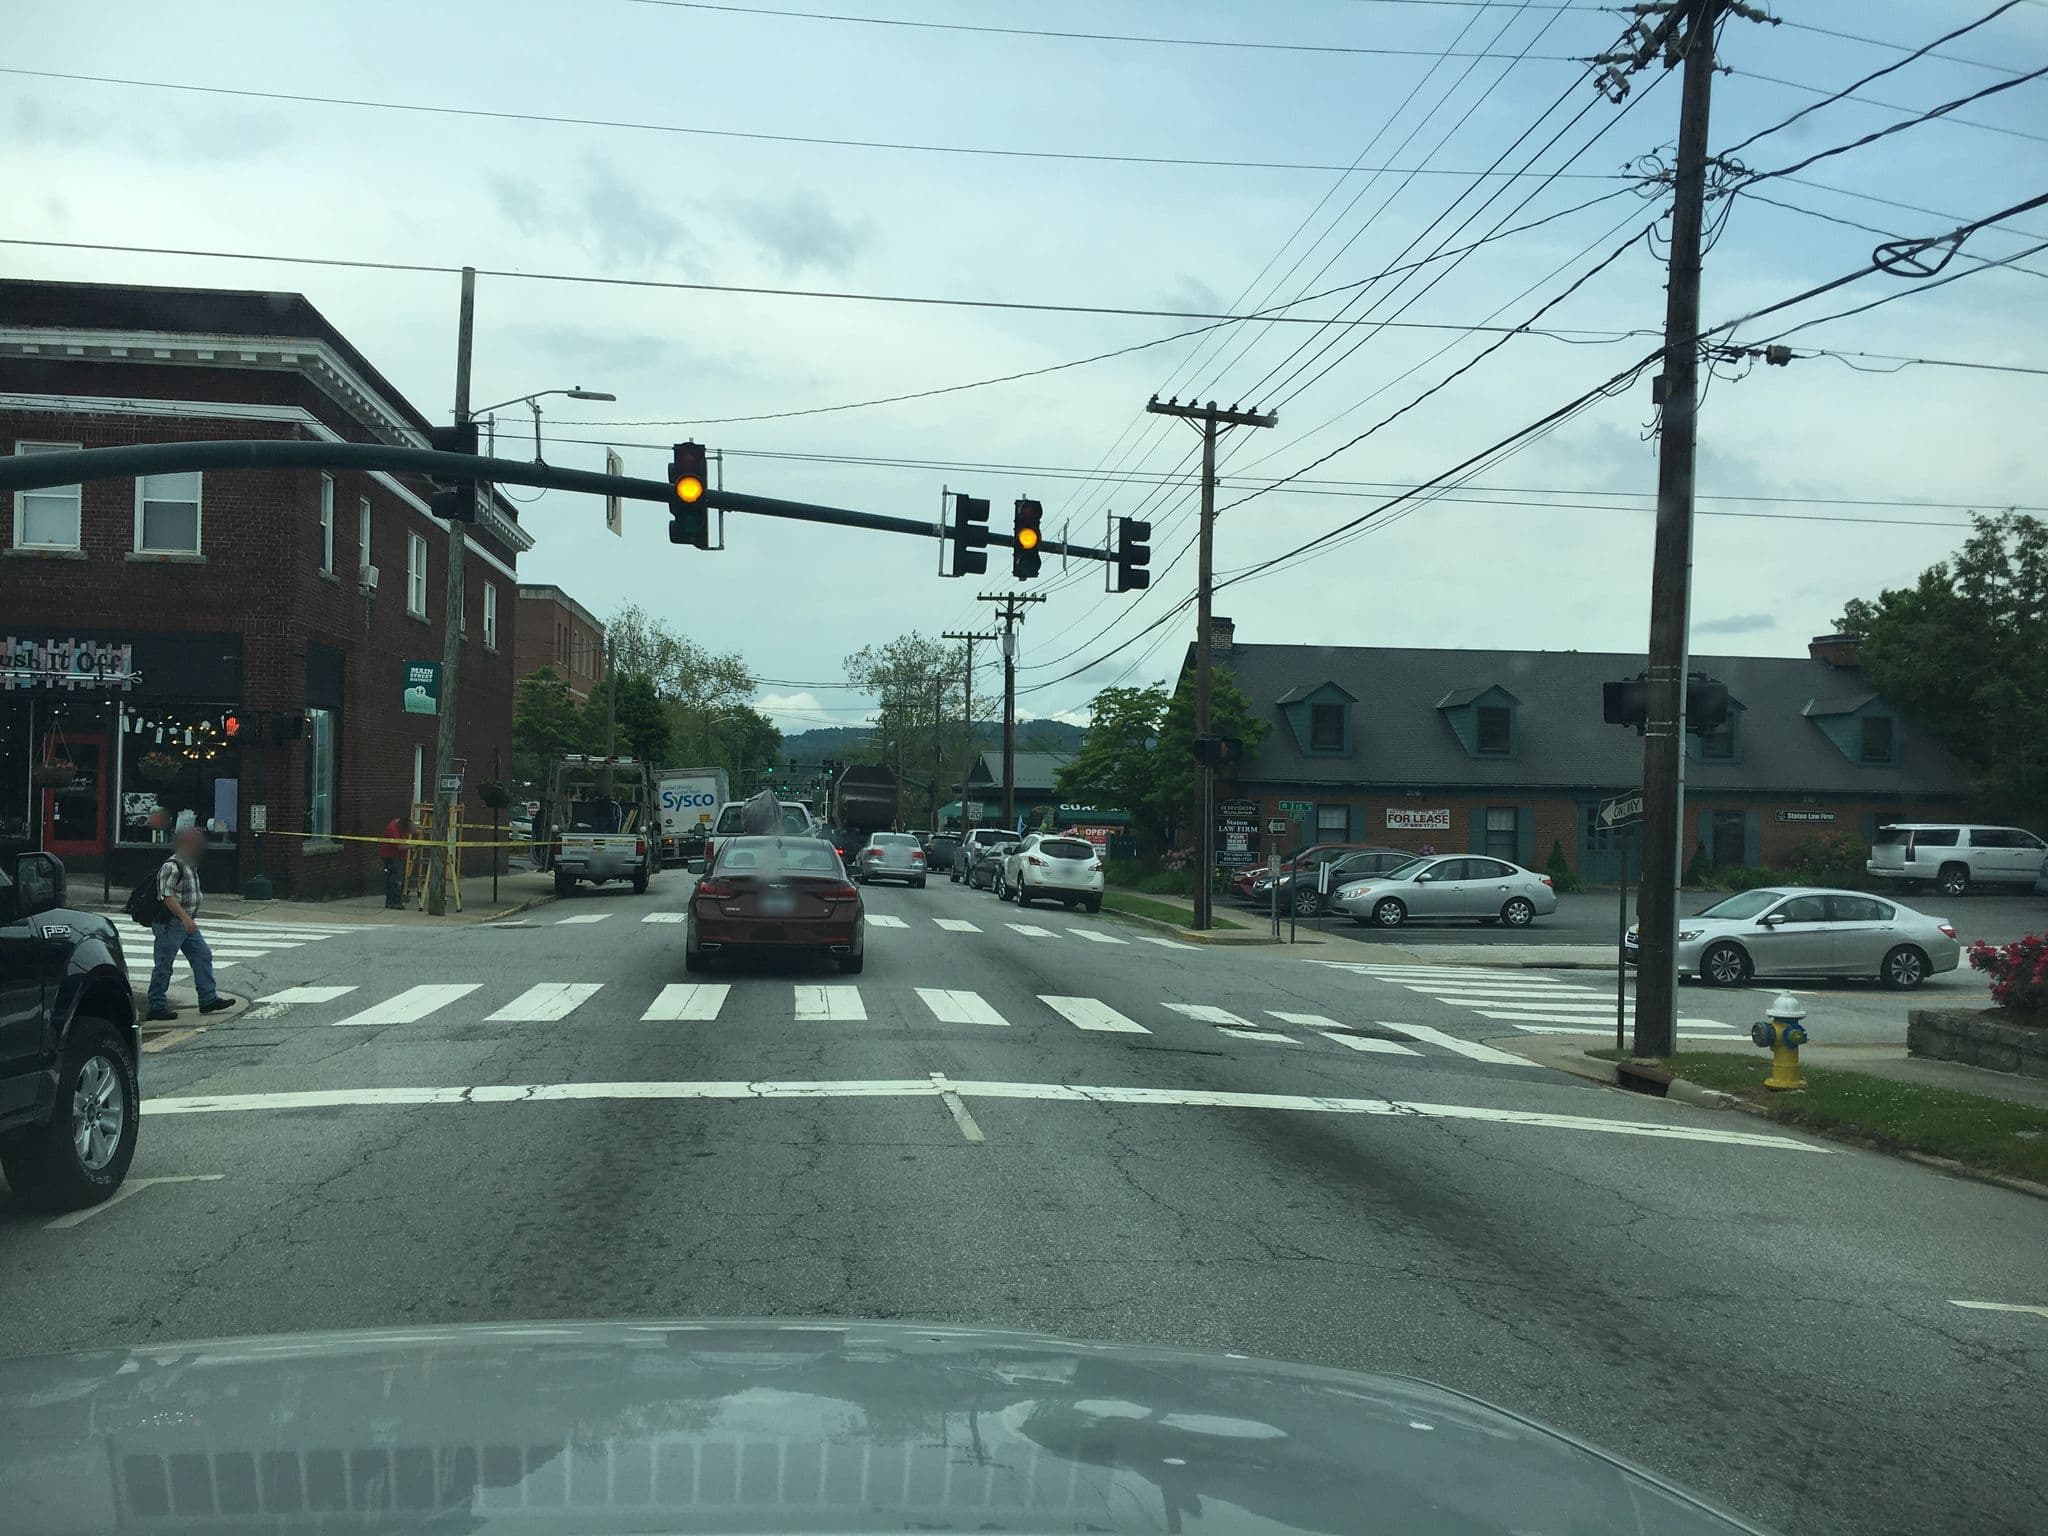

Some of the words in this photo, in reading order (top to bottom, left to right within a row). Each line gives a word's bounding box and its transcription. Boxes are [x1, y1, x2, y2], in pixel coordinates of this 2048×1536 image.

[48, 650, 70, 671] It
[77, 652, 121, 678] Off
[662, 791, 715, 812] Sysco
[970, 811, 982, 819] 20
[1226, 818, 1249, 826] Staton
[1388, 815, 1410, 823] FOR
[1413, 815, 1449, 824] LEASE
[1237, 825, 1258, 833] FIRM
